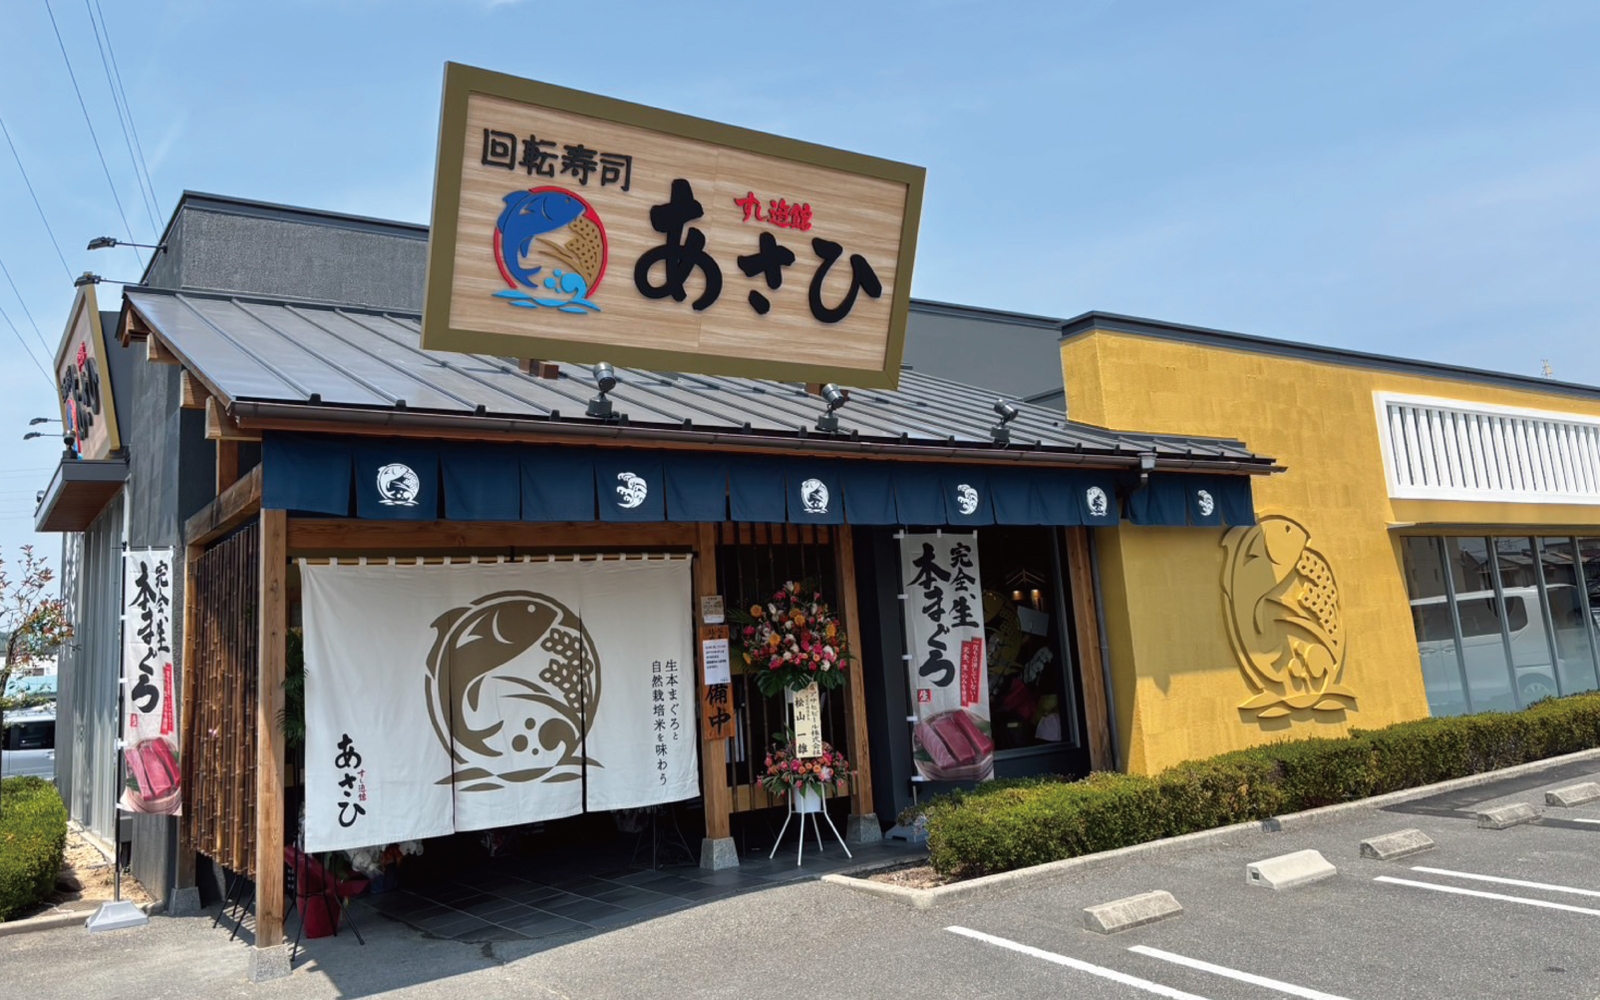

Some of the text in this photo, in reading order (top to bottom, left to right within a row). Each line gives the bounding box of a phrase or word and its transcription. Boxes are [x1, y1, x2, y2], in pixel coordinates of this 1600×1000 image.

[481, 128, 633, 192] 回転寿司
[634, 178, 882, 324] あさひ
[128, 561, 160, 713] 本まぐろ
[907, 542, 956, 687] 本まぐろ
[652, 661, 668, 786] 自然栽培米を味わう
[665, 659, 679, 740] 生本まぐろと
[335, 733, 366, 828] あさひ
